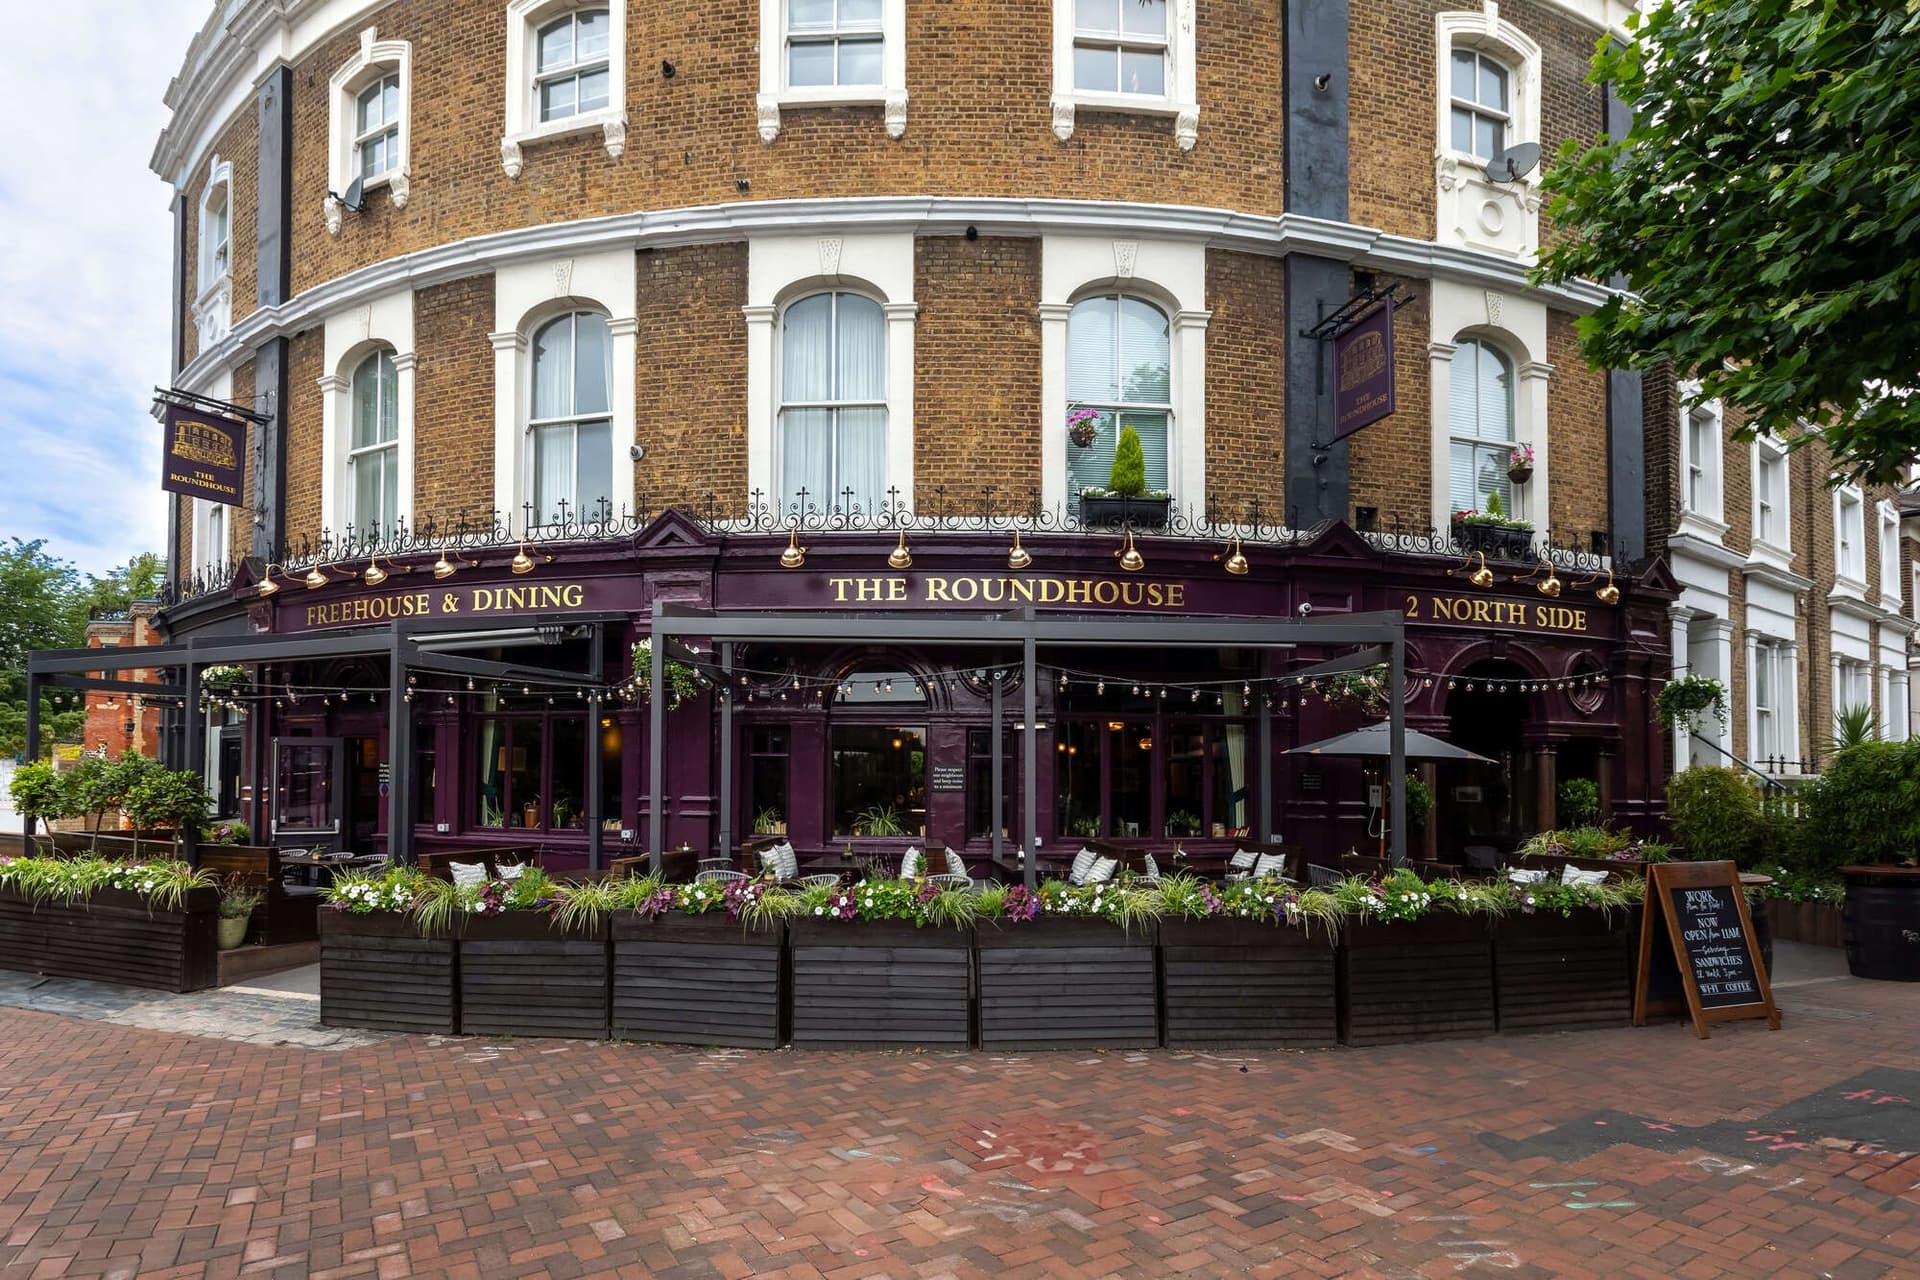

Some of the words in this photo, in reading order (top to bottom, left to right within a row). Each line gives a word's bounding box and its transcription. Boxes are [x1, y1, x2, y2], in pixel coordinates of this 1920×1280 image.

[194, 470, 215, 482] THE
[170, 473, 236, 495] ROUNDHOUSE
[829, 577, 906, 602] THE
[925, 577, 1185, 607] ROUNDHOUSE
[307, 593, 430, 626] FREEHOUSE
[442, 593, 459, 613] &
[472, 584, 584, 612] DINING
[1406, 595, 1419, 617] 2
[1432, 597, 1527, 625] NORTH
[1536, 606, 1587, 631] SIDE
[1685, 889, 1718, 903] WORK
[1697, 917, 1718, 929] NOW
[1684, 928, 1708, 942] OPEN
[1694, 955, 1743, 968] SANDWICHES
